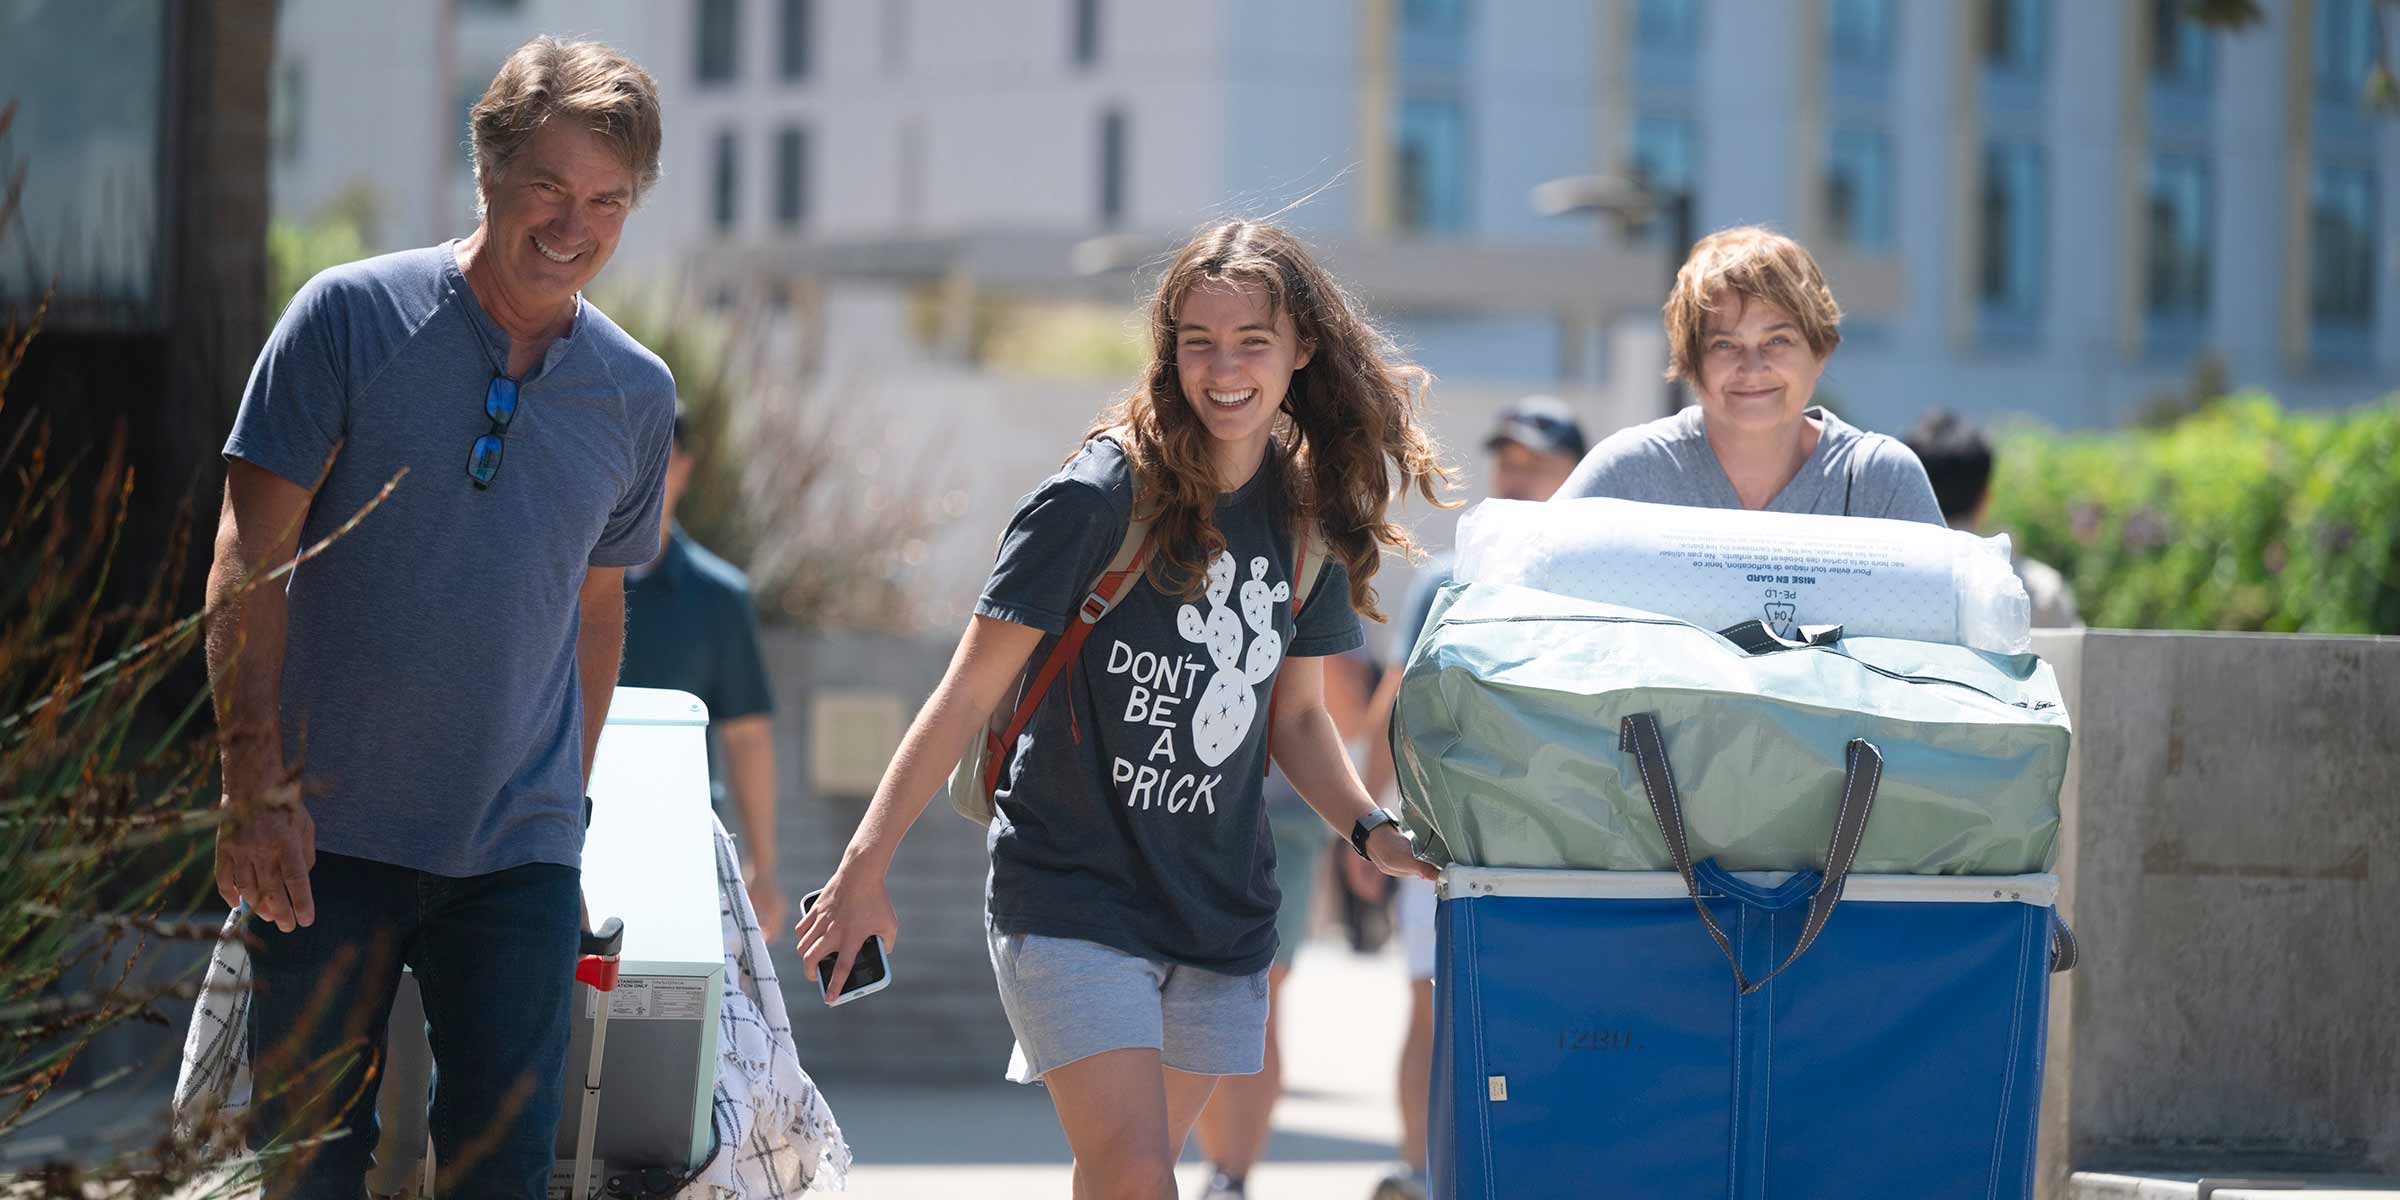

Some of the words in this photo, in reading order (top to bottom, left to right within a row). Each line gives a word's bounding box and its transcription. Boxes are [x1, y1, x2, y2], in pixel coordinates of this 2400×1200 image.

[1659, 551, 1686, 559] utiliser
[1704, 552, 1715, 560] Ne
[1704, 561, 1723, 569] tenir
[1725, 562, 1772, 571] suffocation,
[1773, 564, 1783, 572] de
[1871, 560, 1889, 568] hors
[1784, 564, 1809, 573] risque
[1811, 566, 1827, 574] tout
[1829, 567, 1851, 575] éviter
[1852, 568, 1872, 576] Pour
[1746, 574, 1774, 583] GARD
[1776, 575, 1789, 584] EN
[1791, 576, 1816, 584] MISE
[1774, 610, 1787, 621] 04
[1107, 640, 1206, 699] DON'T
[1123, 685, 1182, 729] BE
[1148, 728, 1177, 764] A
[1112, 756, 1223, 815] PRICK
